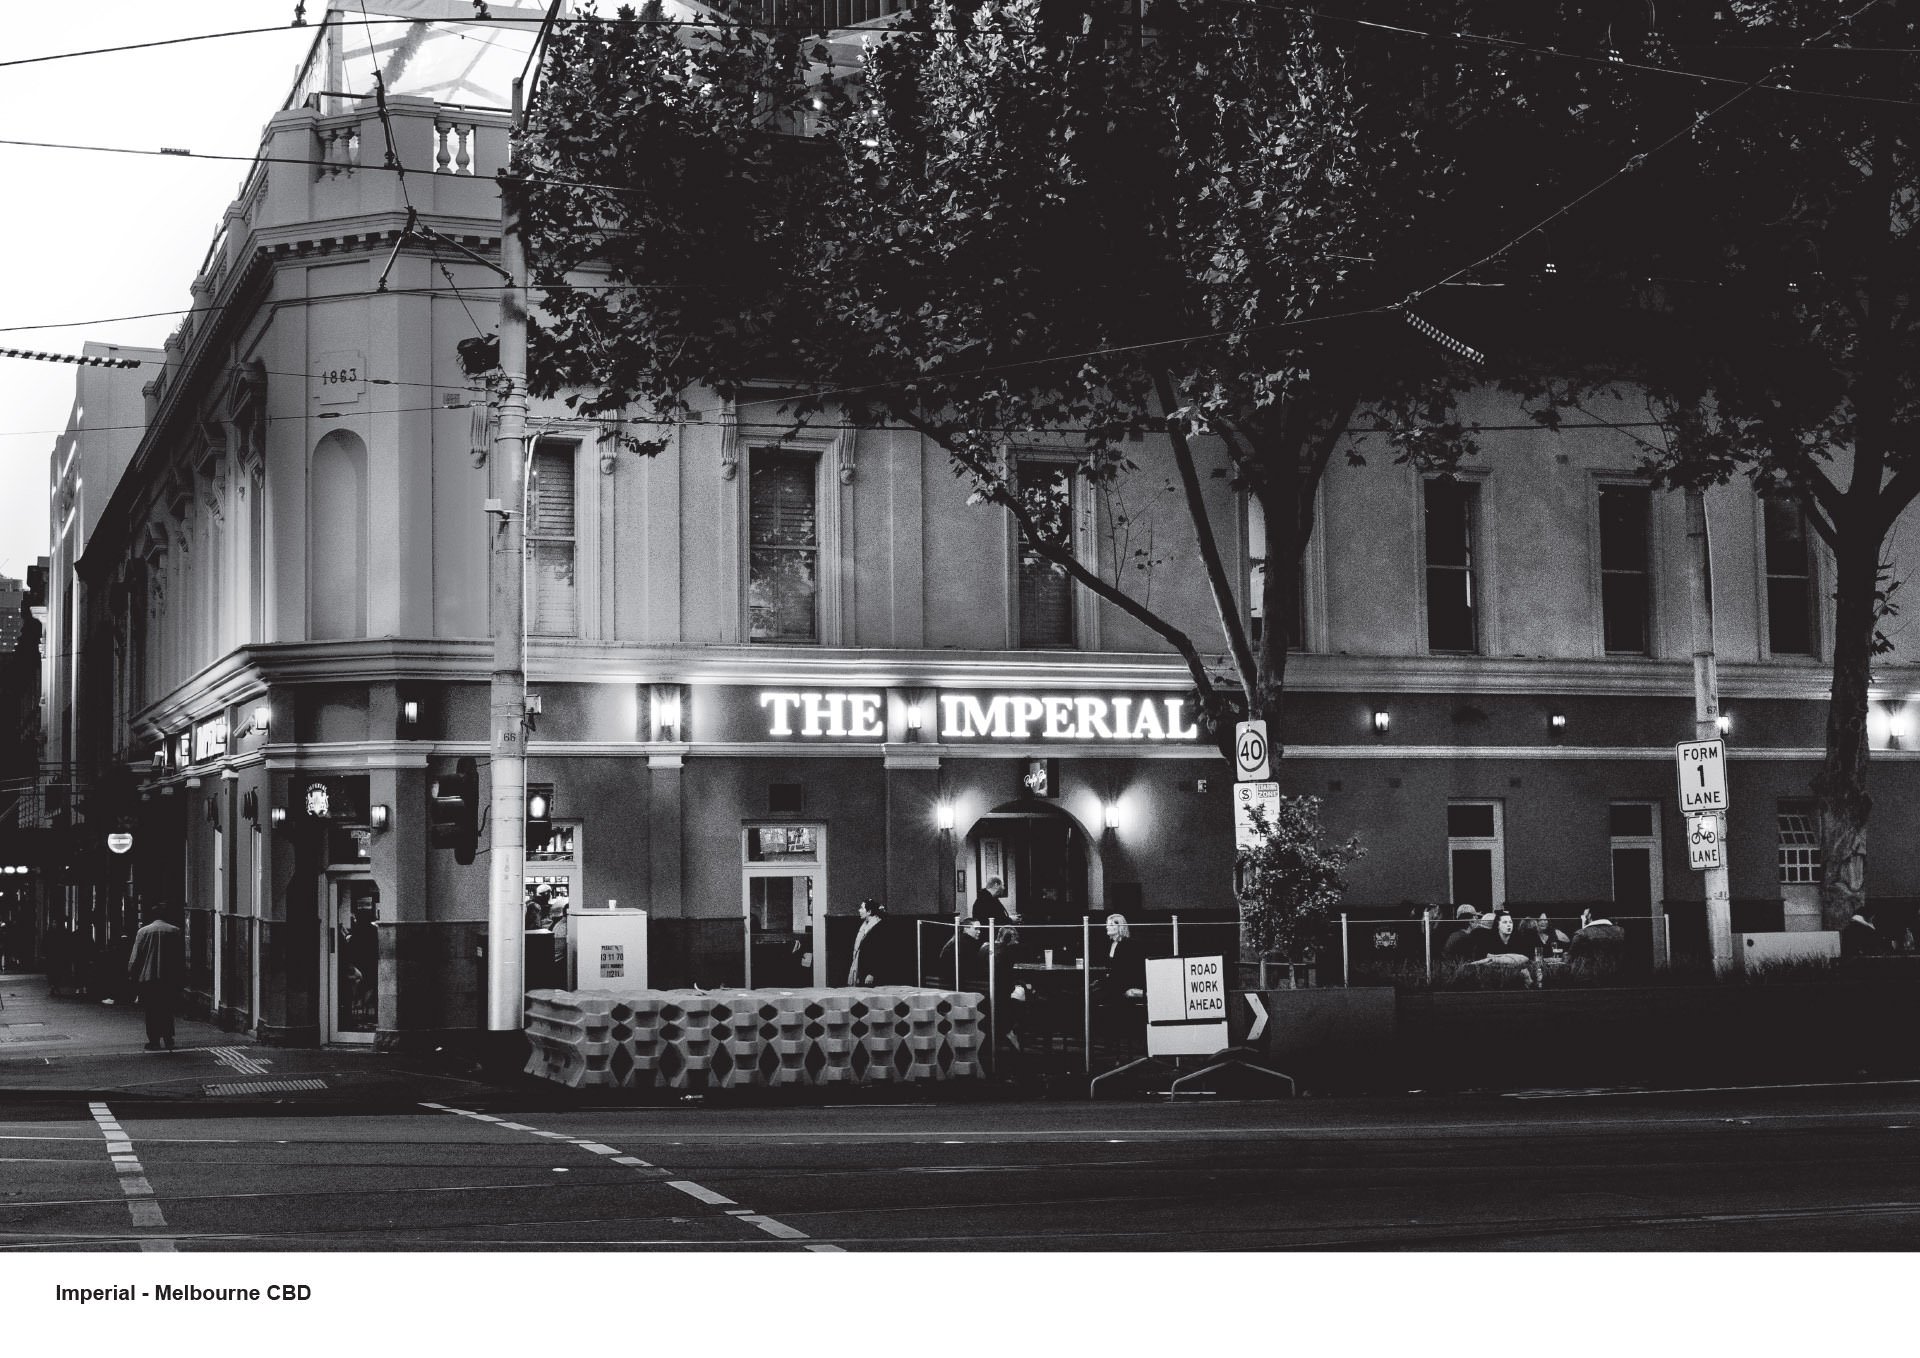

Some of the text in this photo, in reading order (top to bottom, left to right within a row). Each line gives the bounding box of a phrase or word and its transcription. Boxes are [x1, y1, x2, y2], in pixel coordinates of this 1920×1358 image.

[322, 368, 357, 386] 1863
[760, 692, 1198, 740] THE IMPERIAL
[1240, 739, 1263, 761] 40
[1683, 746, 1718, 760] FORM
[1697, 765, 1705, 787] 1
[1686, 791, 1721, 805] LANE
[1692, 850, 1718, 863] LANE
[1190, 963, 1217, 976] ROAD
[1190, 980, 1219, 993] WORK
[1189, 998, 1223, 1011] AHEAD
